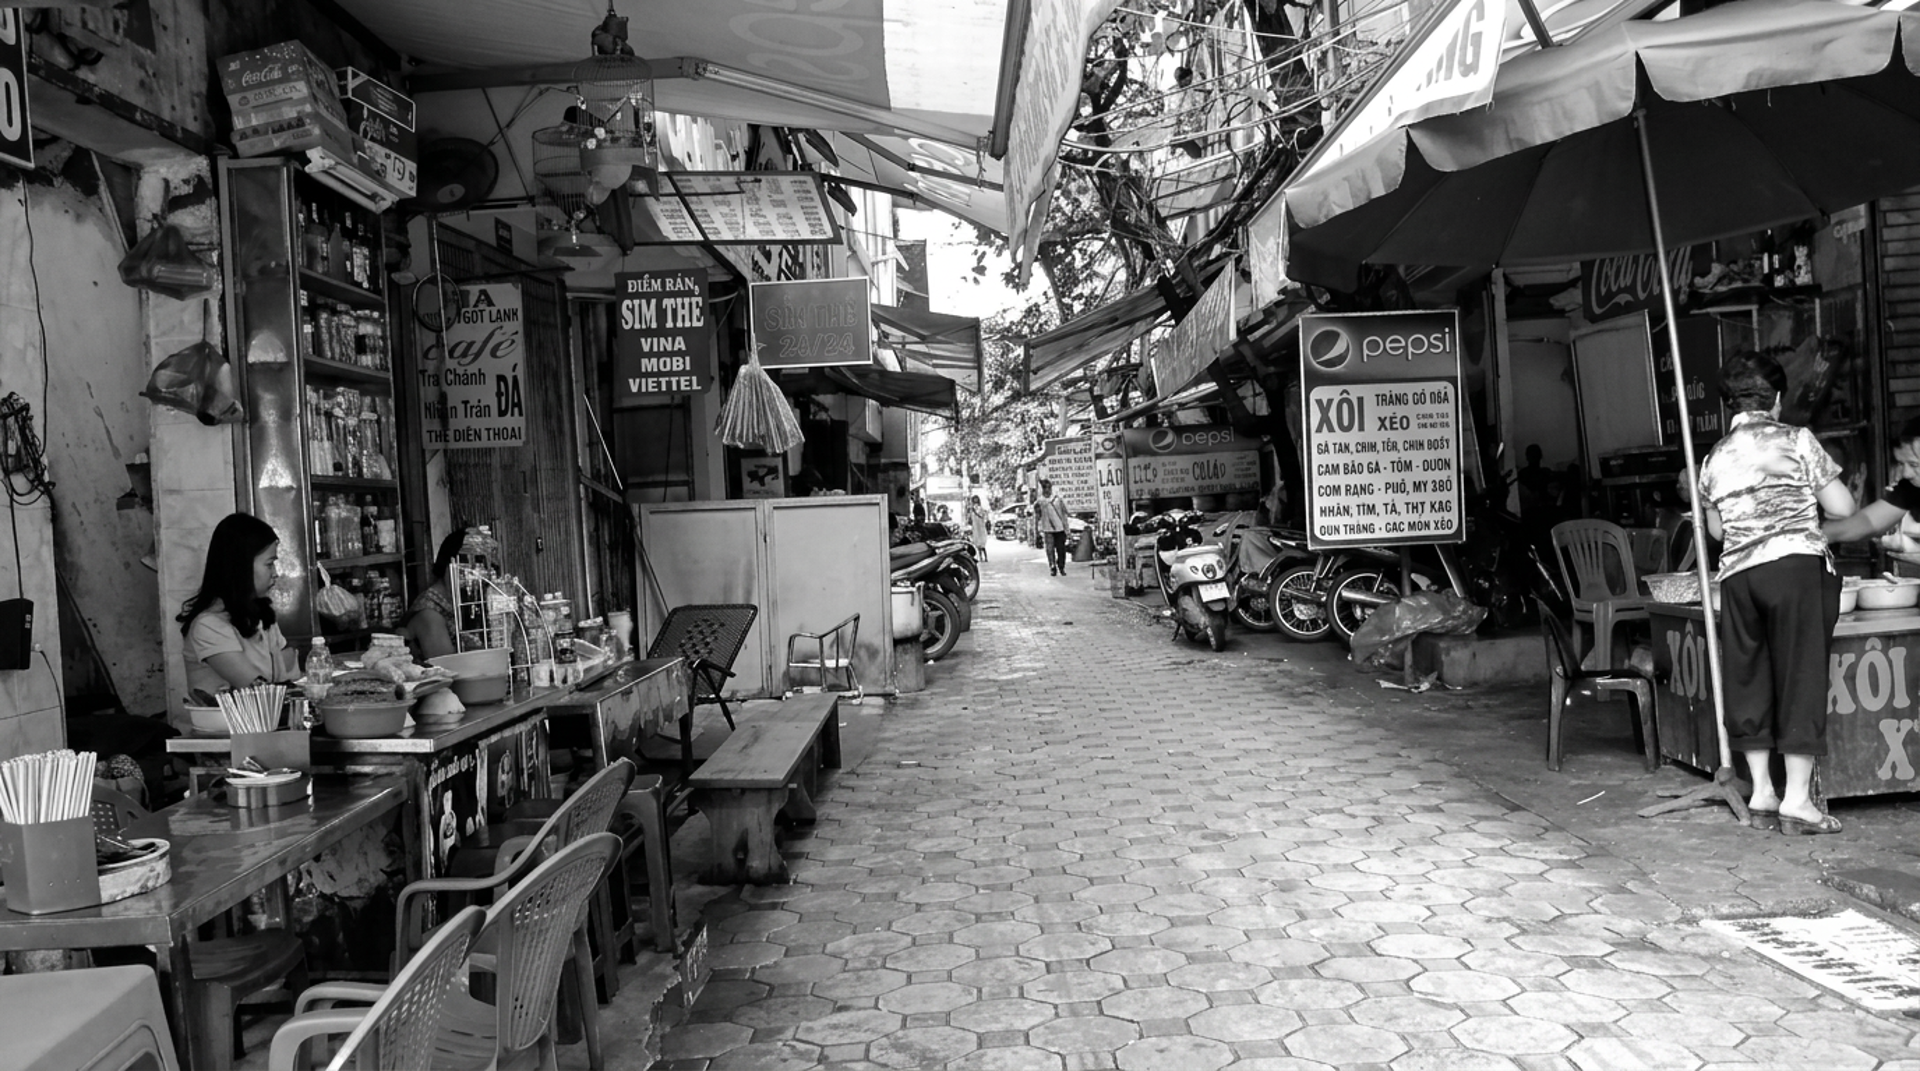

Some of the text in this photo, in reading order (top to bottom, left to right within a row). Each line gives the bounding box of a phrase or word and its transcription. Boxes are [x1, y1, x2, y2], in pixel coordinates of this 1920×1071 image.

[621, 297, 659, 330] SIM
[640, 335, 687, 353] VINA
[1362, 327, 1451, 363] pepsi
[640, 355, 692, 373] MOBI
[627, 375, 702, 394] VIETTEL
[1315, 388, 1366, 434] XÔI
[1317, 463, 1341, 476] CAM
[1666, 618, 1707, 701] XÔI
[1827, 636, 1911, 715] XÔI
